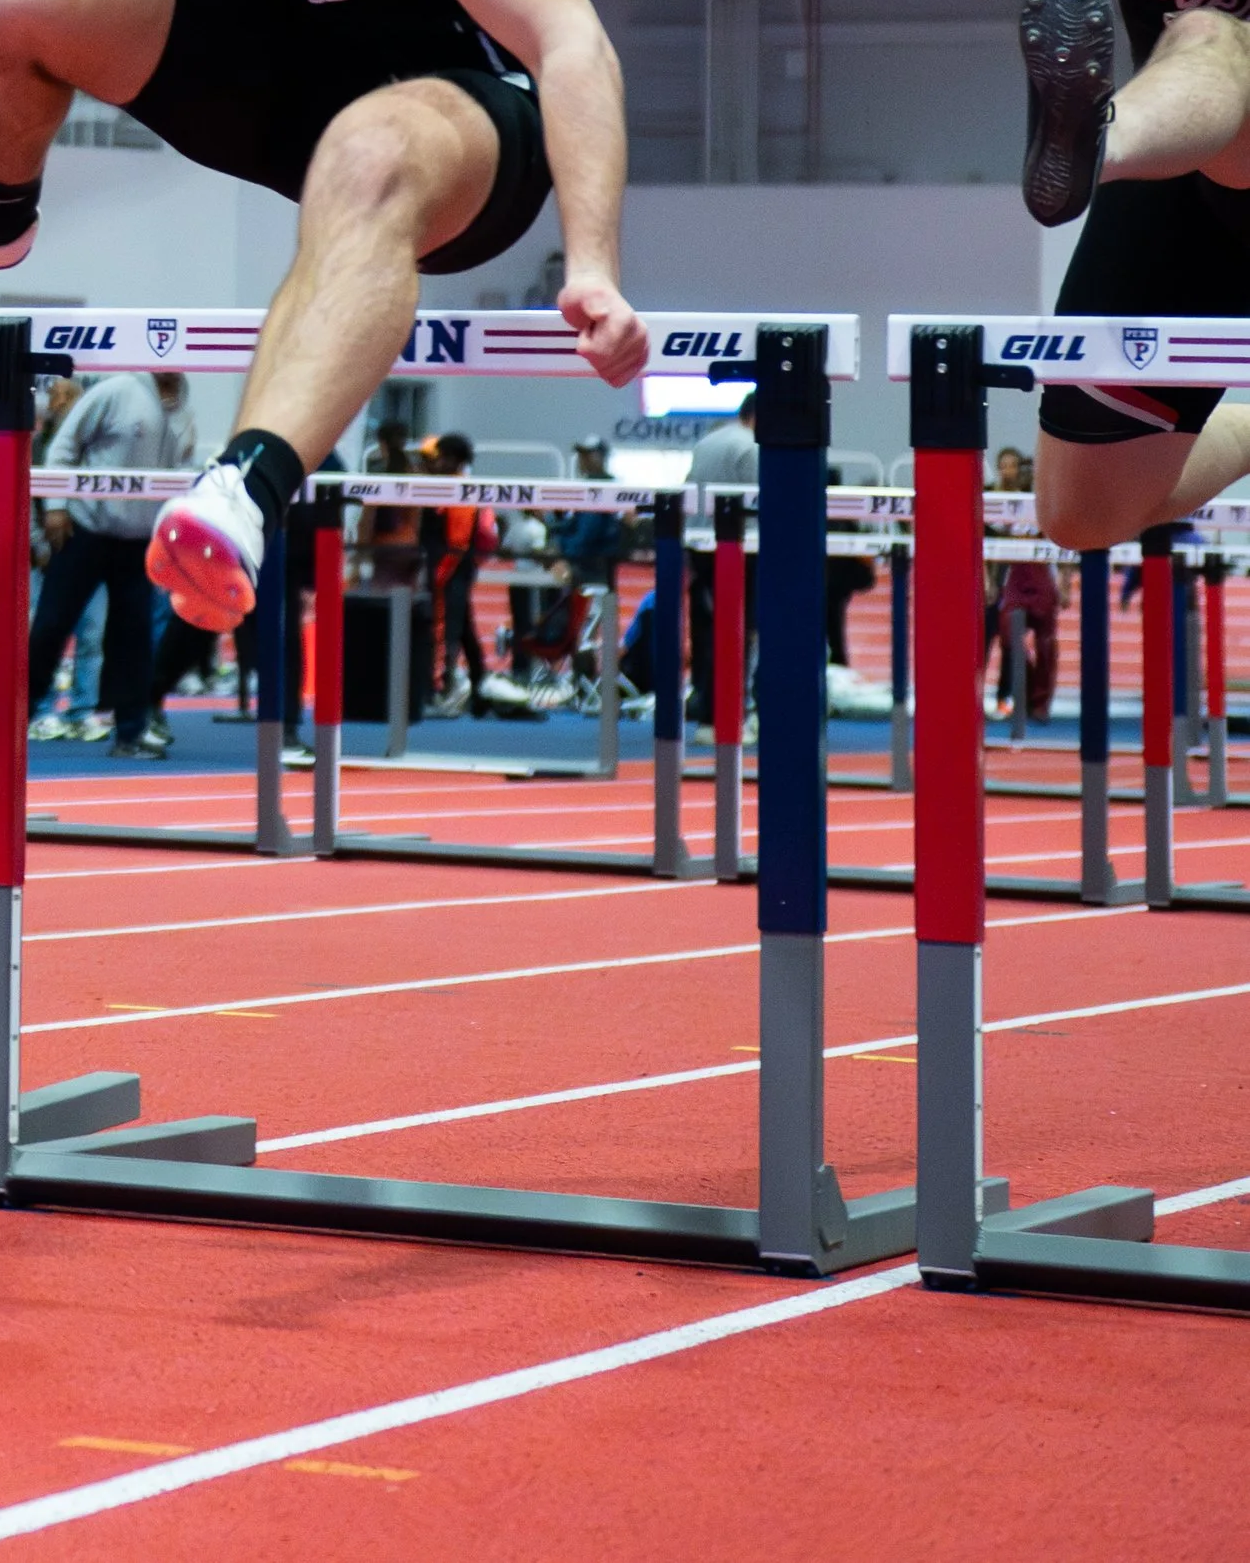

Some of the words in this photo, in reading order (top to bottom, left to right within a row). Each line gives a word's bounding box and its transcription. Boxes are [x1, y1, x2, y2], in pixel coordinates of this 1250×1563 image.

[43, 325, 116, 350] GILL
[662, 332, 743, 357] GILL
[1001, 335, 1086, 361] GILL
[75, 474, 146, 493] PENN
[460, 484, 535, 503] PENN
